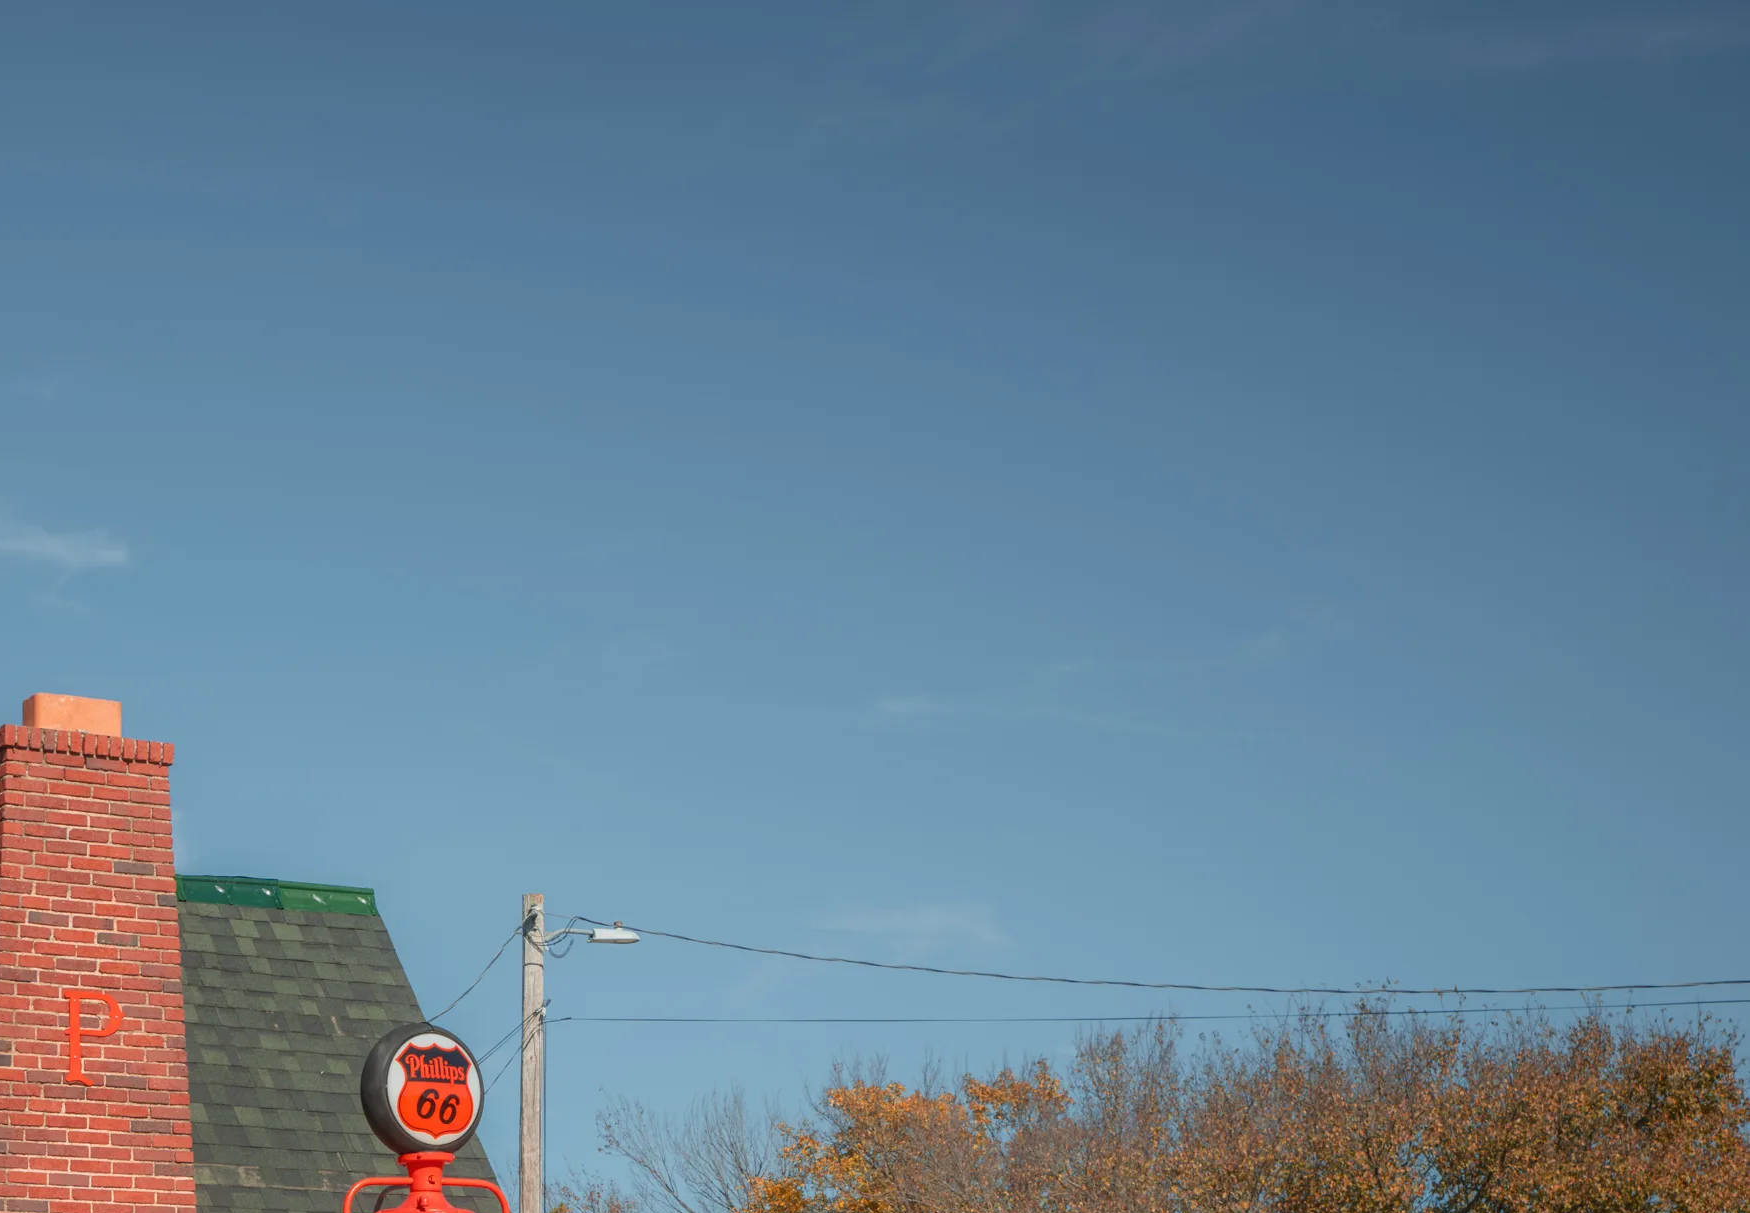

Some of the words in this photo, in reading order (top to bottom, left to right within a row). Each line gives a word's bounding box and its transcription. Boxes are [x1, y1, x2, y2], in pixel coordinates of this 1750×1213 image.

[64, 991, 125, 1086] P
[405, 1053, 465, 1087] Phillips
[416, 1088, 460, 1125] 66
